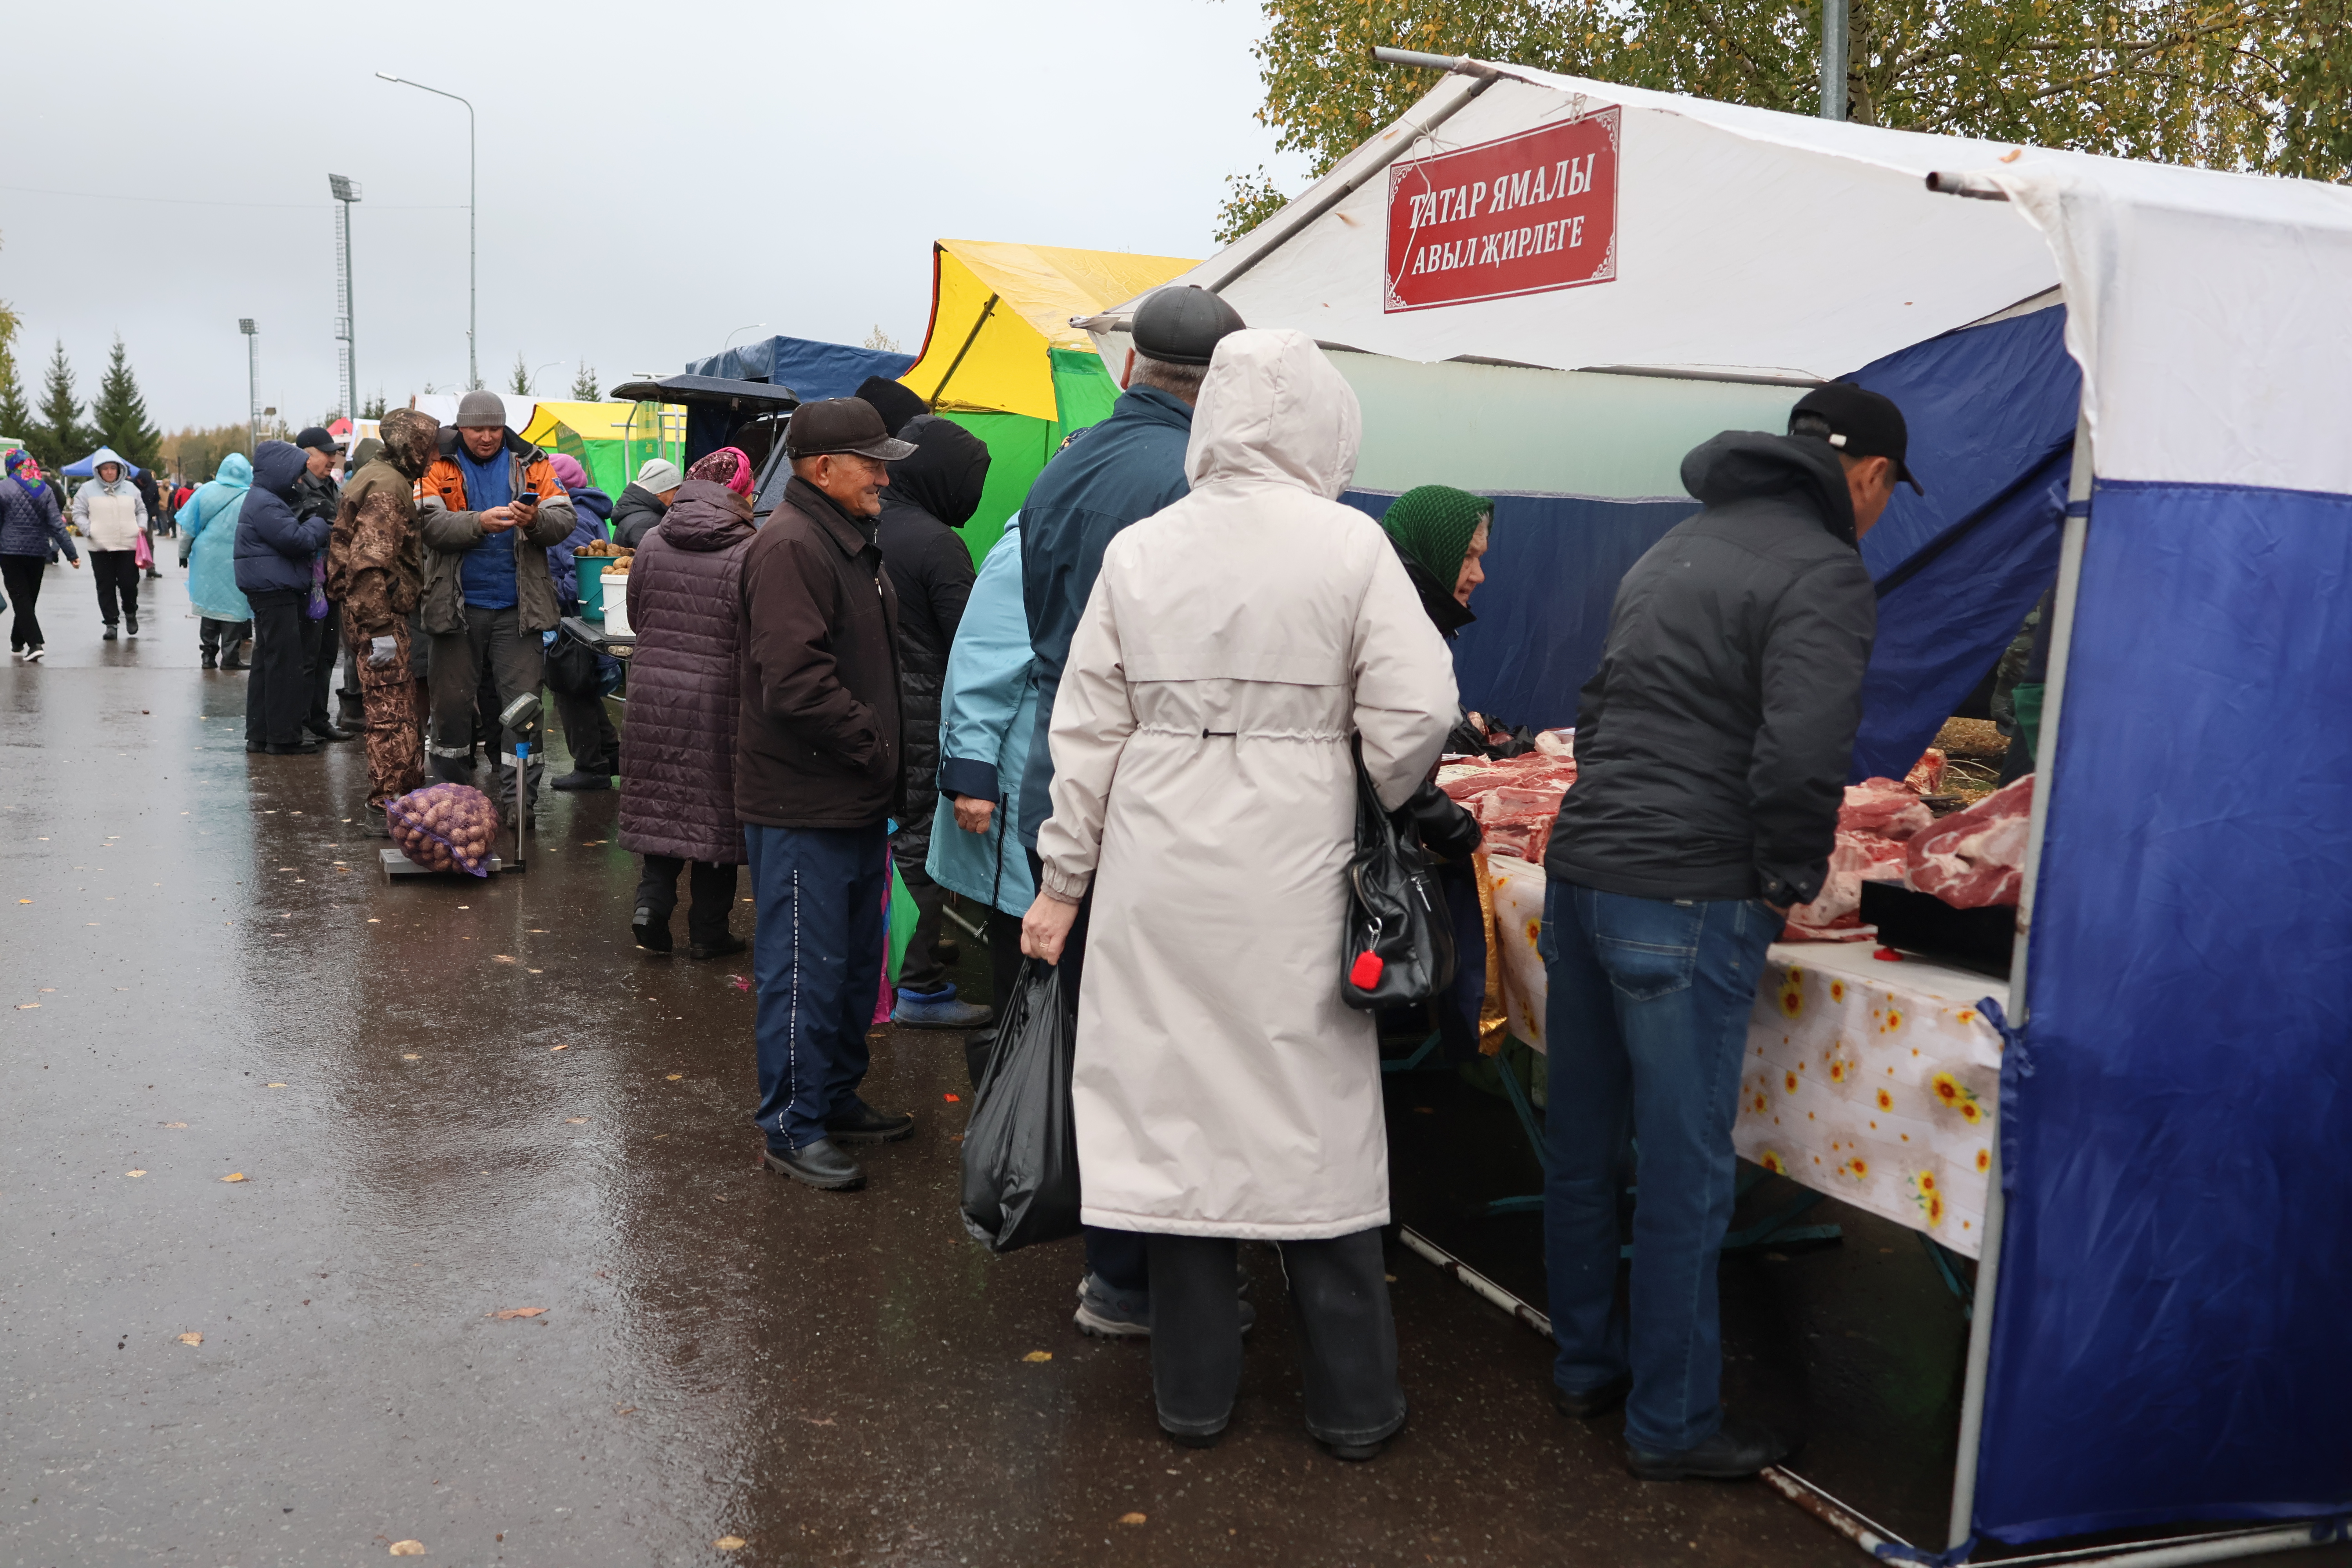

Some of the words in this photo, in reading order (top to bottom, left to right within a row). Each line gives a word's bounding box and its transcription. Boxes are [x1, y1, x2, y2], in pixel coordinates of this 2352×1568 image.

[1409, 181, 1486, 229] ТАТАР
[1488, 153, 1595, 213] ЯМАЛЫ
[1412, 237, 1477, 275] АВЫЛ
[1479, 215, 1585, 269] ҖИРЛЕГЕ
